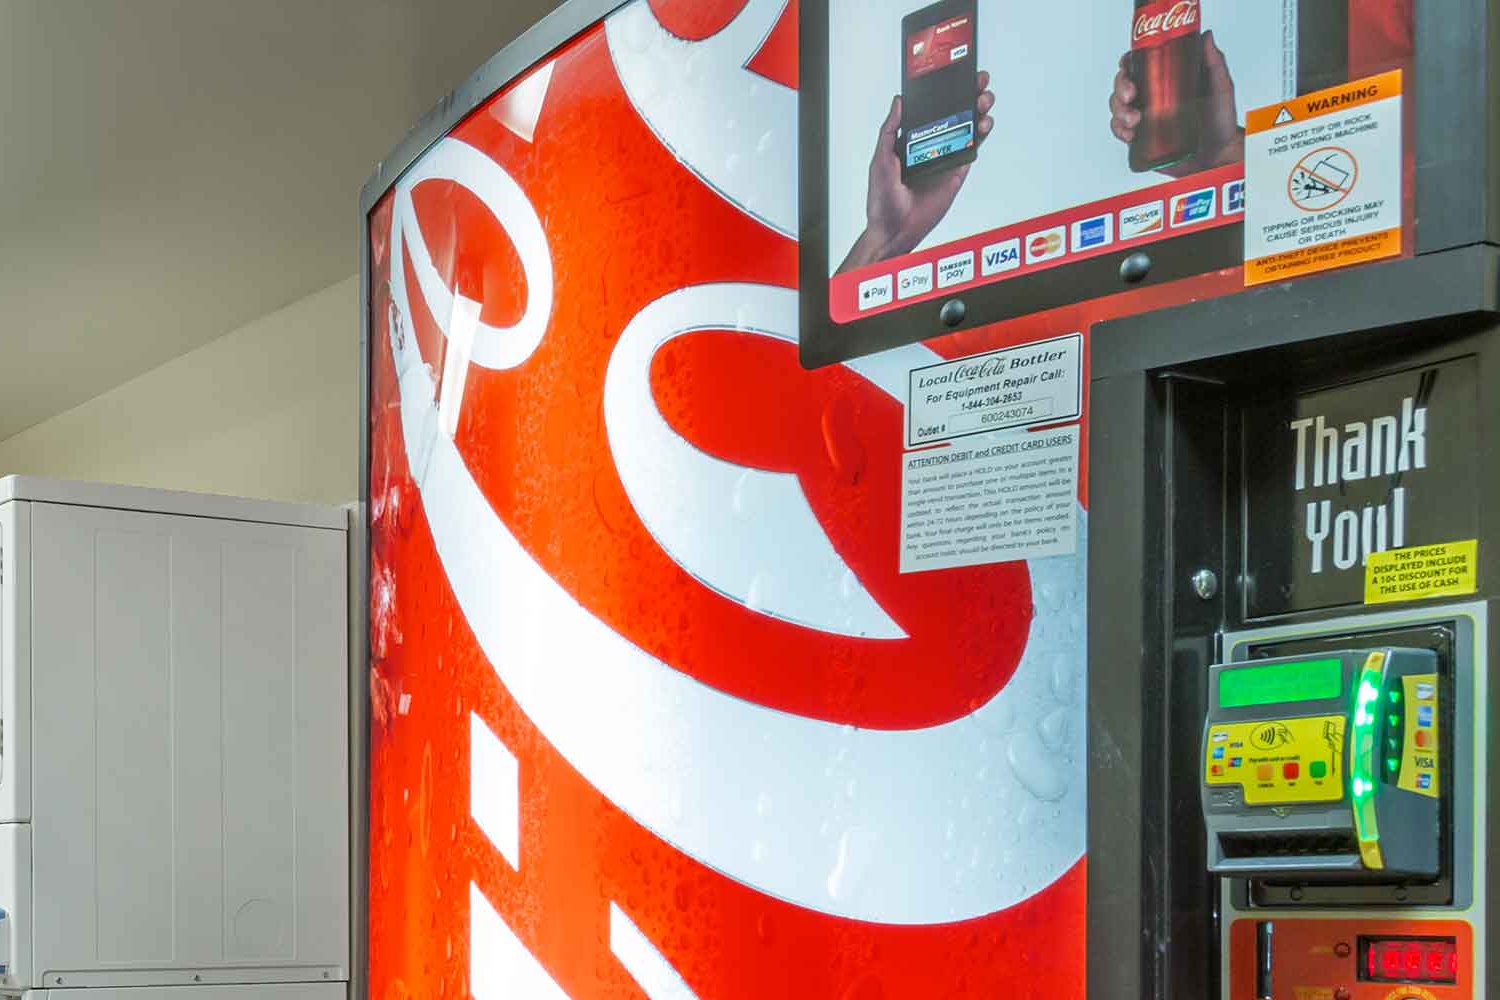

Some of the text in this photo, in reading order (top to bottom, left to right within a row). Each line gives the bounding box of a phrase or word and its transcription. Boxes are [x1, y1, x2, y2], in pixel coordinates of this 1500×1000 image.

[1307, 85, 1378, 112] WARNING
[1268, 121, 1378, 155] THIS VENDING MACHINE
[1274, 113, 1370, 145] DO NOT TIP OR ROCK
[1123, 210, 1159, 224] DISCOVER
[1262, 200, 1383, 233] TIPPING OR ROCKING MAY
[1266, 211, 1378, 241] CAUSE SERIOUS INJURY
[1298, 228, 1346, 245] OR DEATH
[986, 248, 1018, 266] VISA
[1338, 243, 1380, 257] PRODUCT
[939, 259, 972, 272] SAMSUNG
[946, 268, 965, 281] pay
[912, 274, 929, 287] Pay
[871, 286, 888, 298] Pay
[919, 373, 952, 388] Local
[1010, 350, 1066, 370] Bottler
[926, 368, 1066, 405] For Equipment Repair Call:
[916, 424, 939, 438] Outlet
[908, 433, 1072, 469] ATTENTION DEBIT and CREDIT CARD USERS
[1290, 397, 1428, 490] Thank
[1395, 547, 1446, 560] THE PRICES
[1374, 554, 1467, 574] DISPLAYED INCLUDE
[1372, 576, 1378, 584] A
[1399, 568, 1446, 581] DISCOUNT
[1449, 566, 1468, 575] FOR
[1380, 577, 1459, 594] THE USE OF CASH
[1415, 755, 1434, 768] VISA
